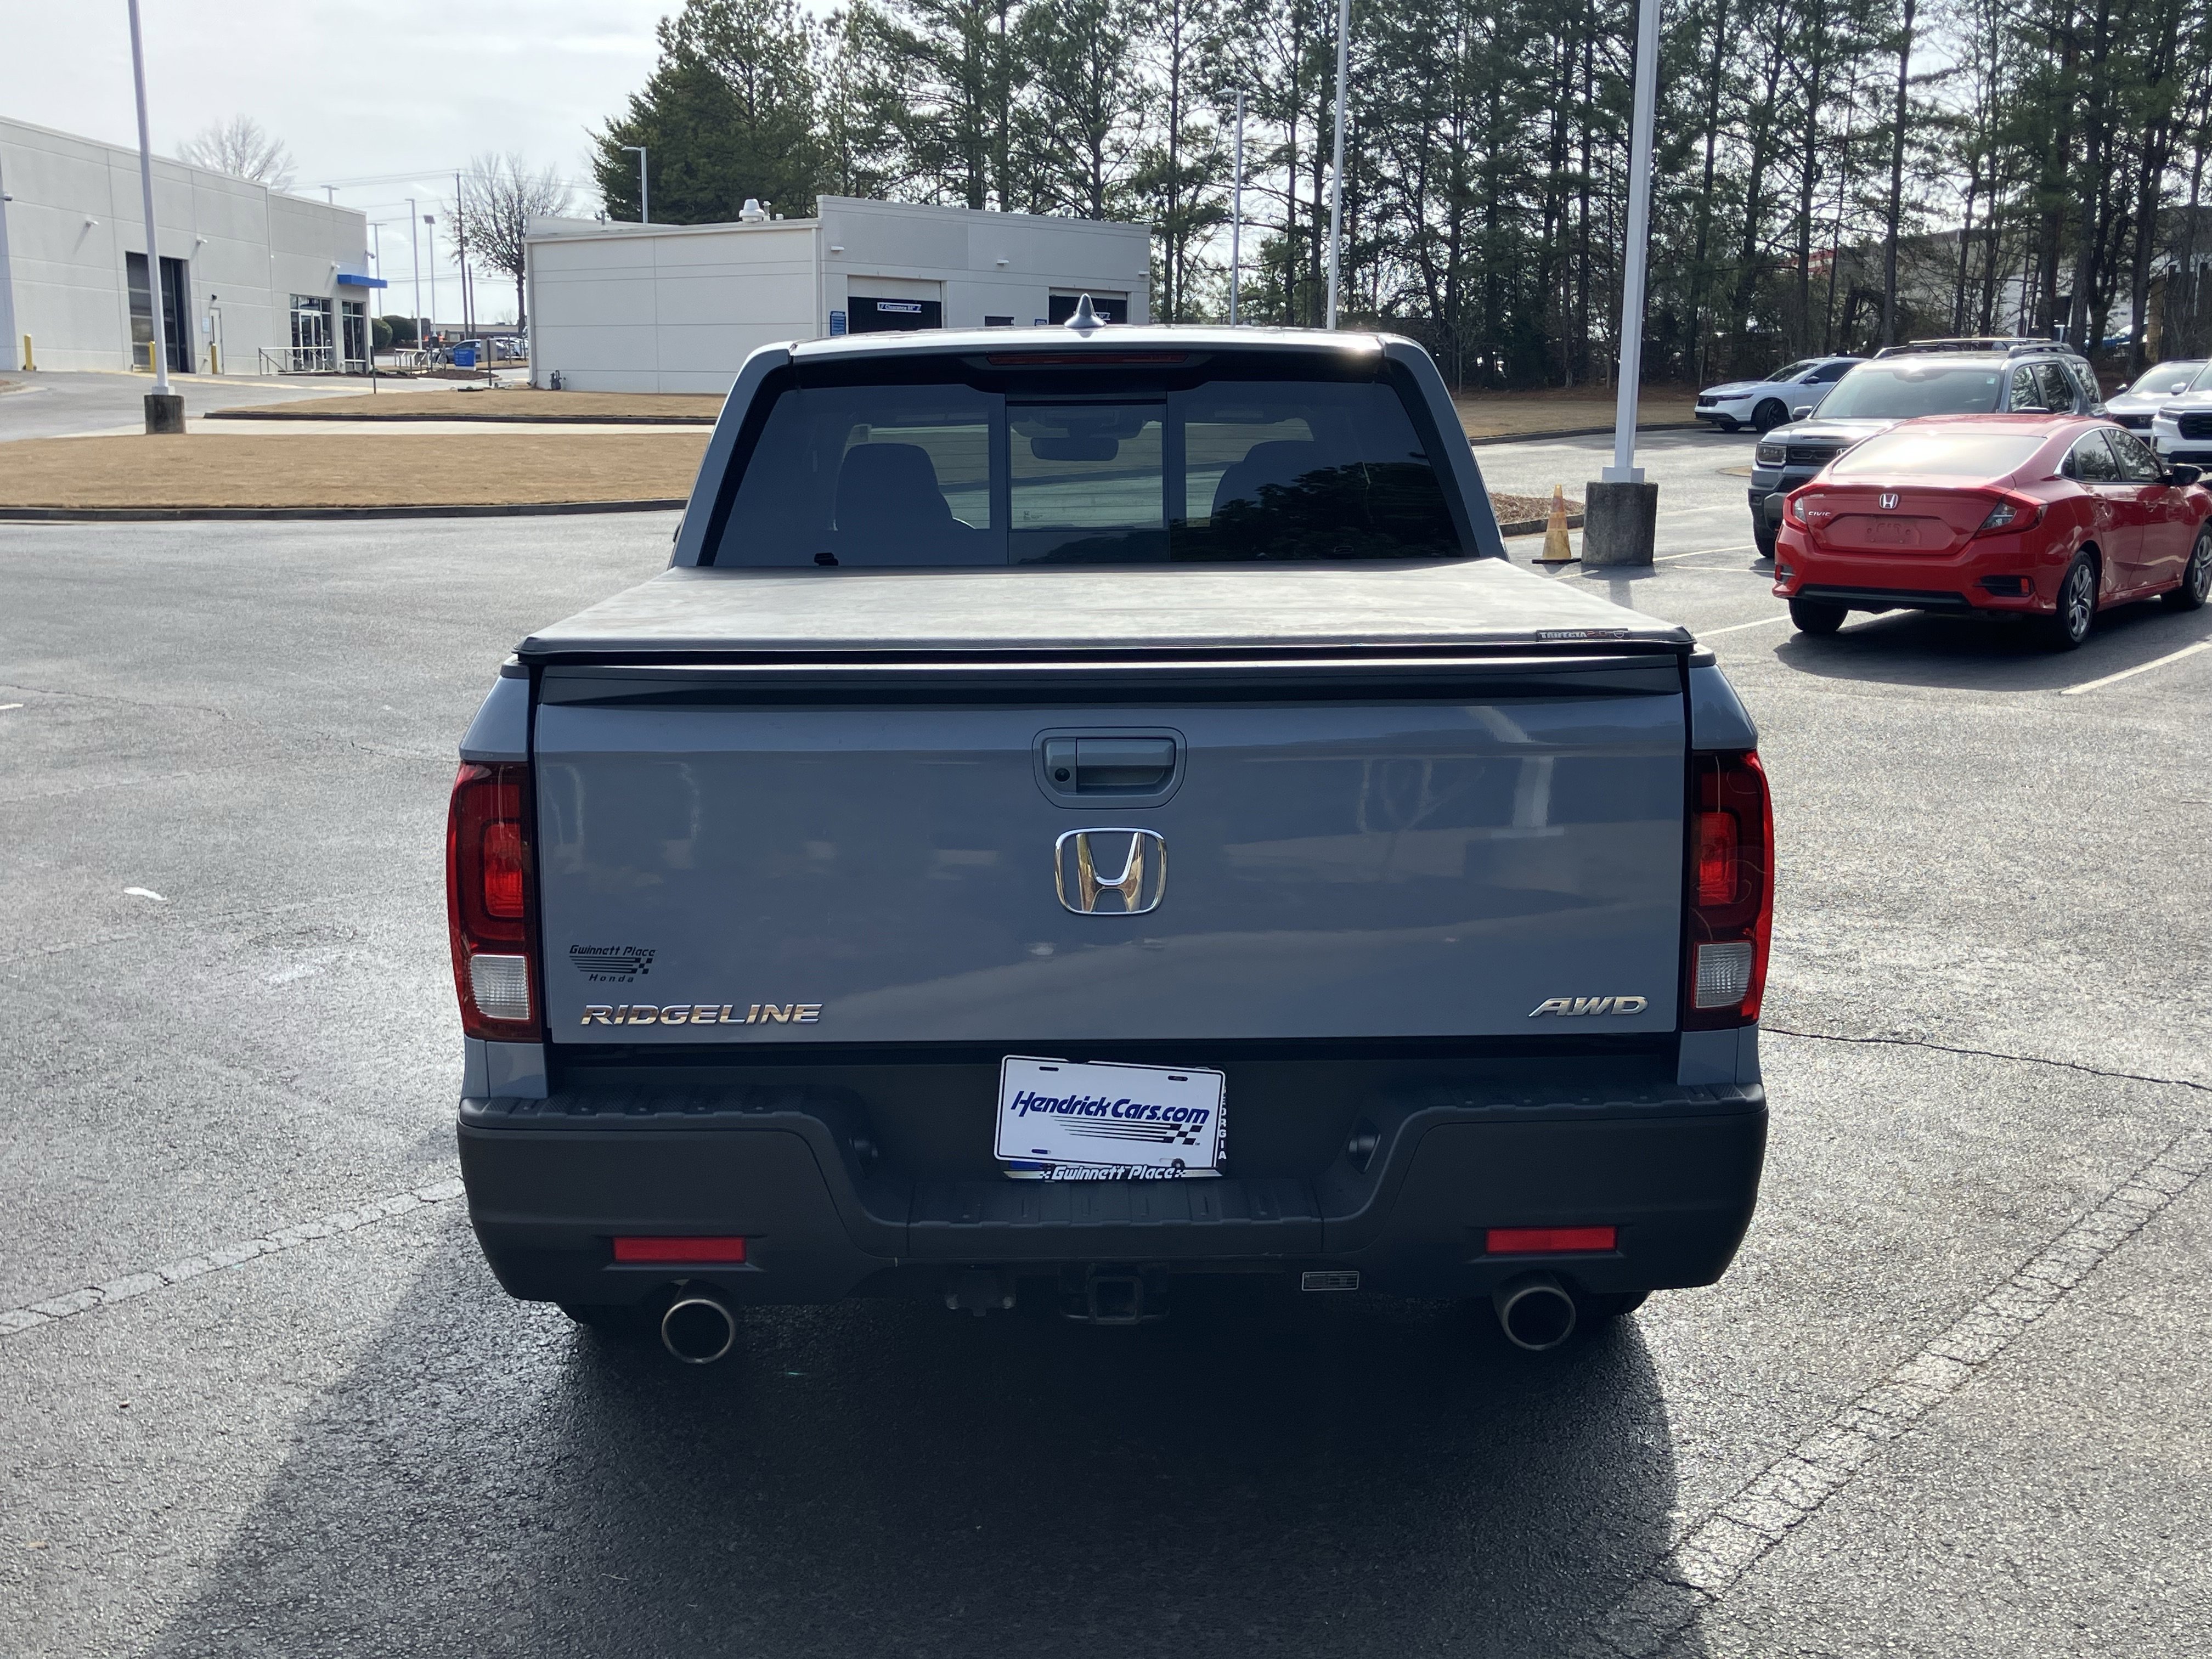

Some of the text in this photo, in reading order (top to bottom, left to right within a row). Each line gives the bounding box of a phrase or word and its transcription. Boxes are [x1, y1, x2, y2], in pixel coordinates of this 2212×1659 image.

[569, 945, 656, 957] Gwinnett Place
[589, 974, 634, 983] Honda
[580, 1003, 823, 1025] RIDGELINE
[1528, 996, 1648, 1017] AWD
[1011, 1091, 1210, 1124] HendrickCars.com
[1051, 1165, 1175, 1180] Gwinnett Place
